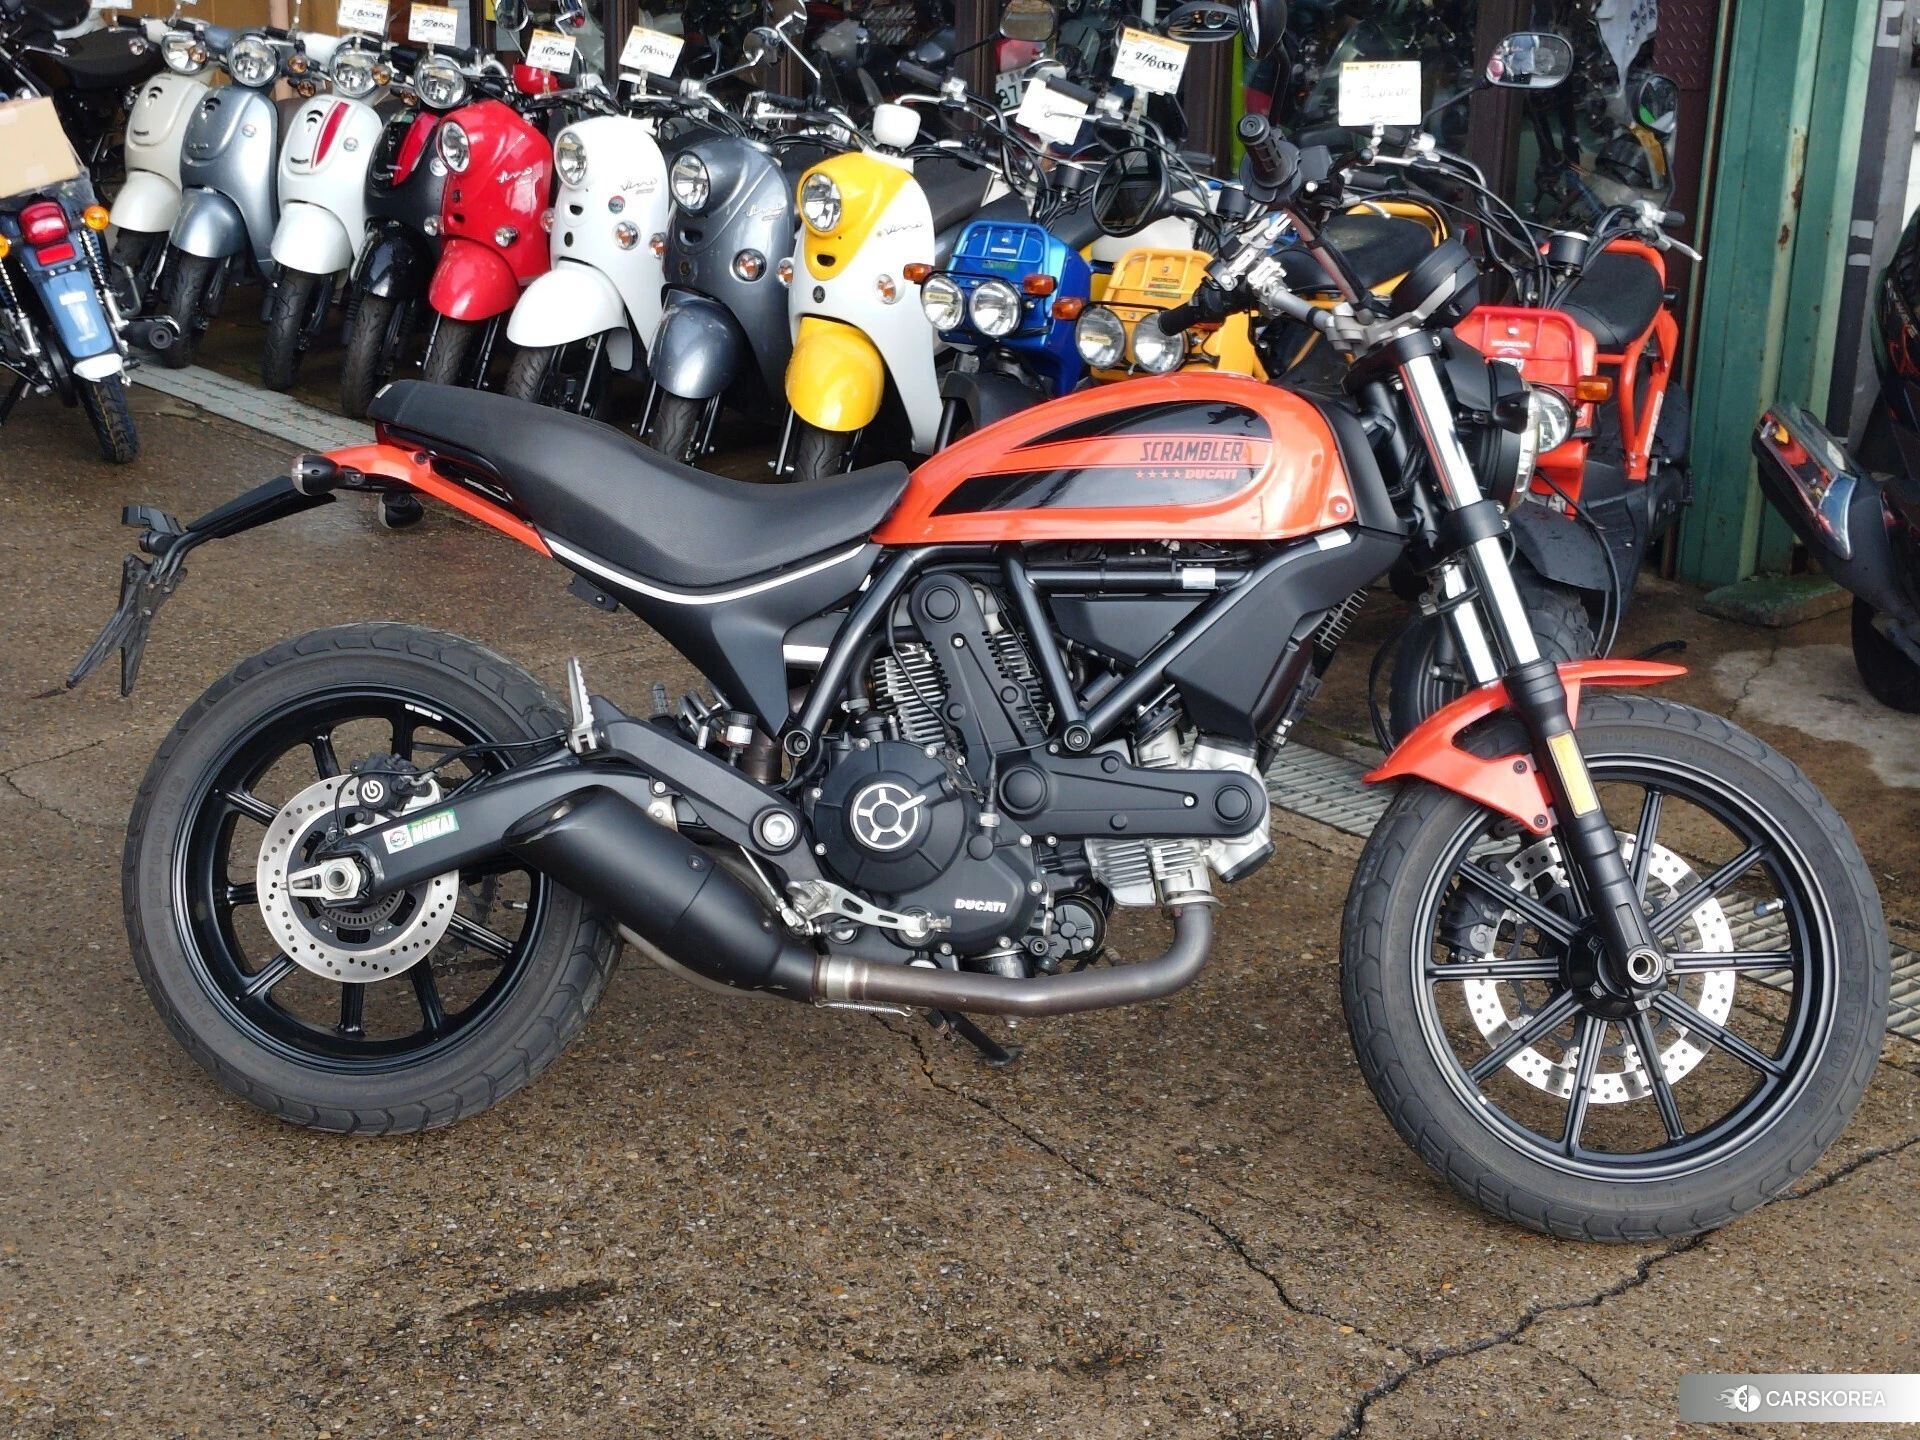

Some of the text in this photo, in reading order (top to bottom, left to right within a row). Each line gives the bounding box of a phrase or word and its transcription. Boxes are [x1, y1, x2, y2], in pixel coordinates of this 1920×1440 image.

[1139, 441, 1244, 462] SCRAMBLER
[1184, 468, 1238, 480] DUCATI
[954, 899, 1007, 913] DUCATI
